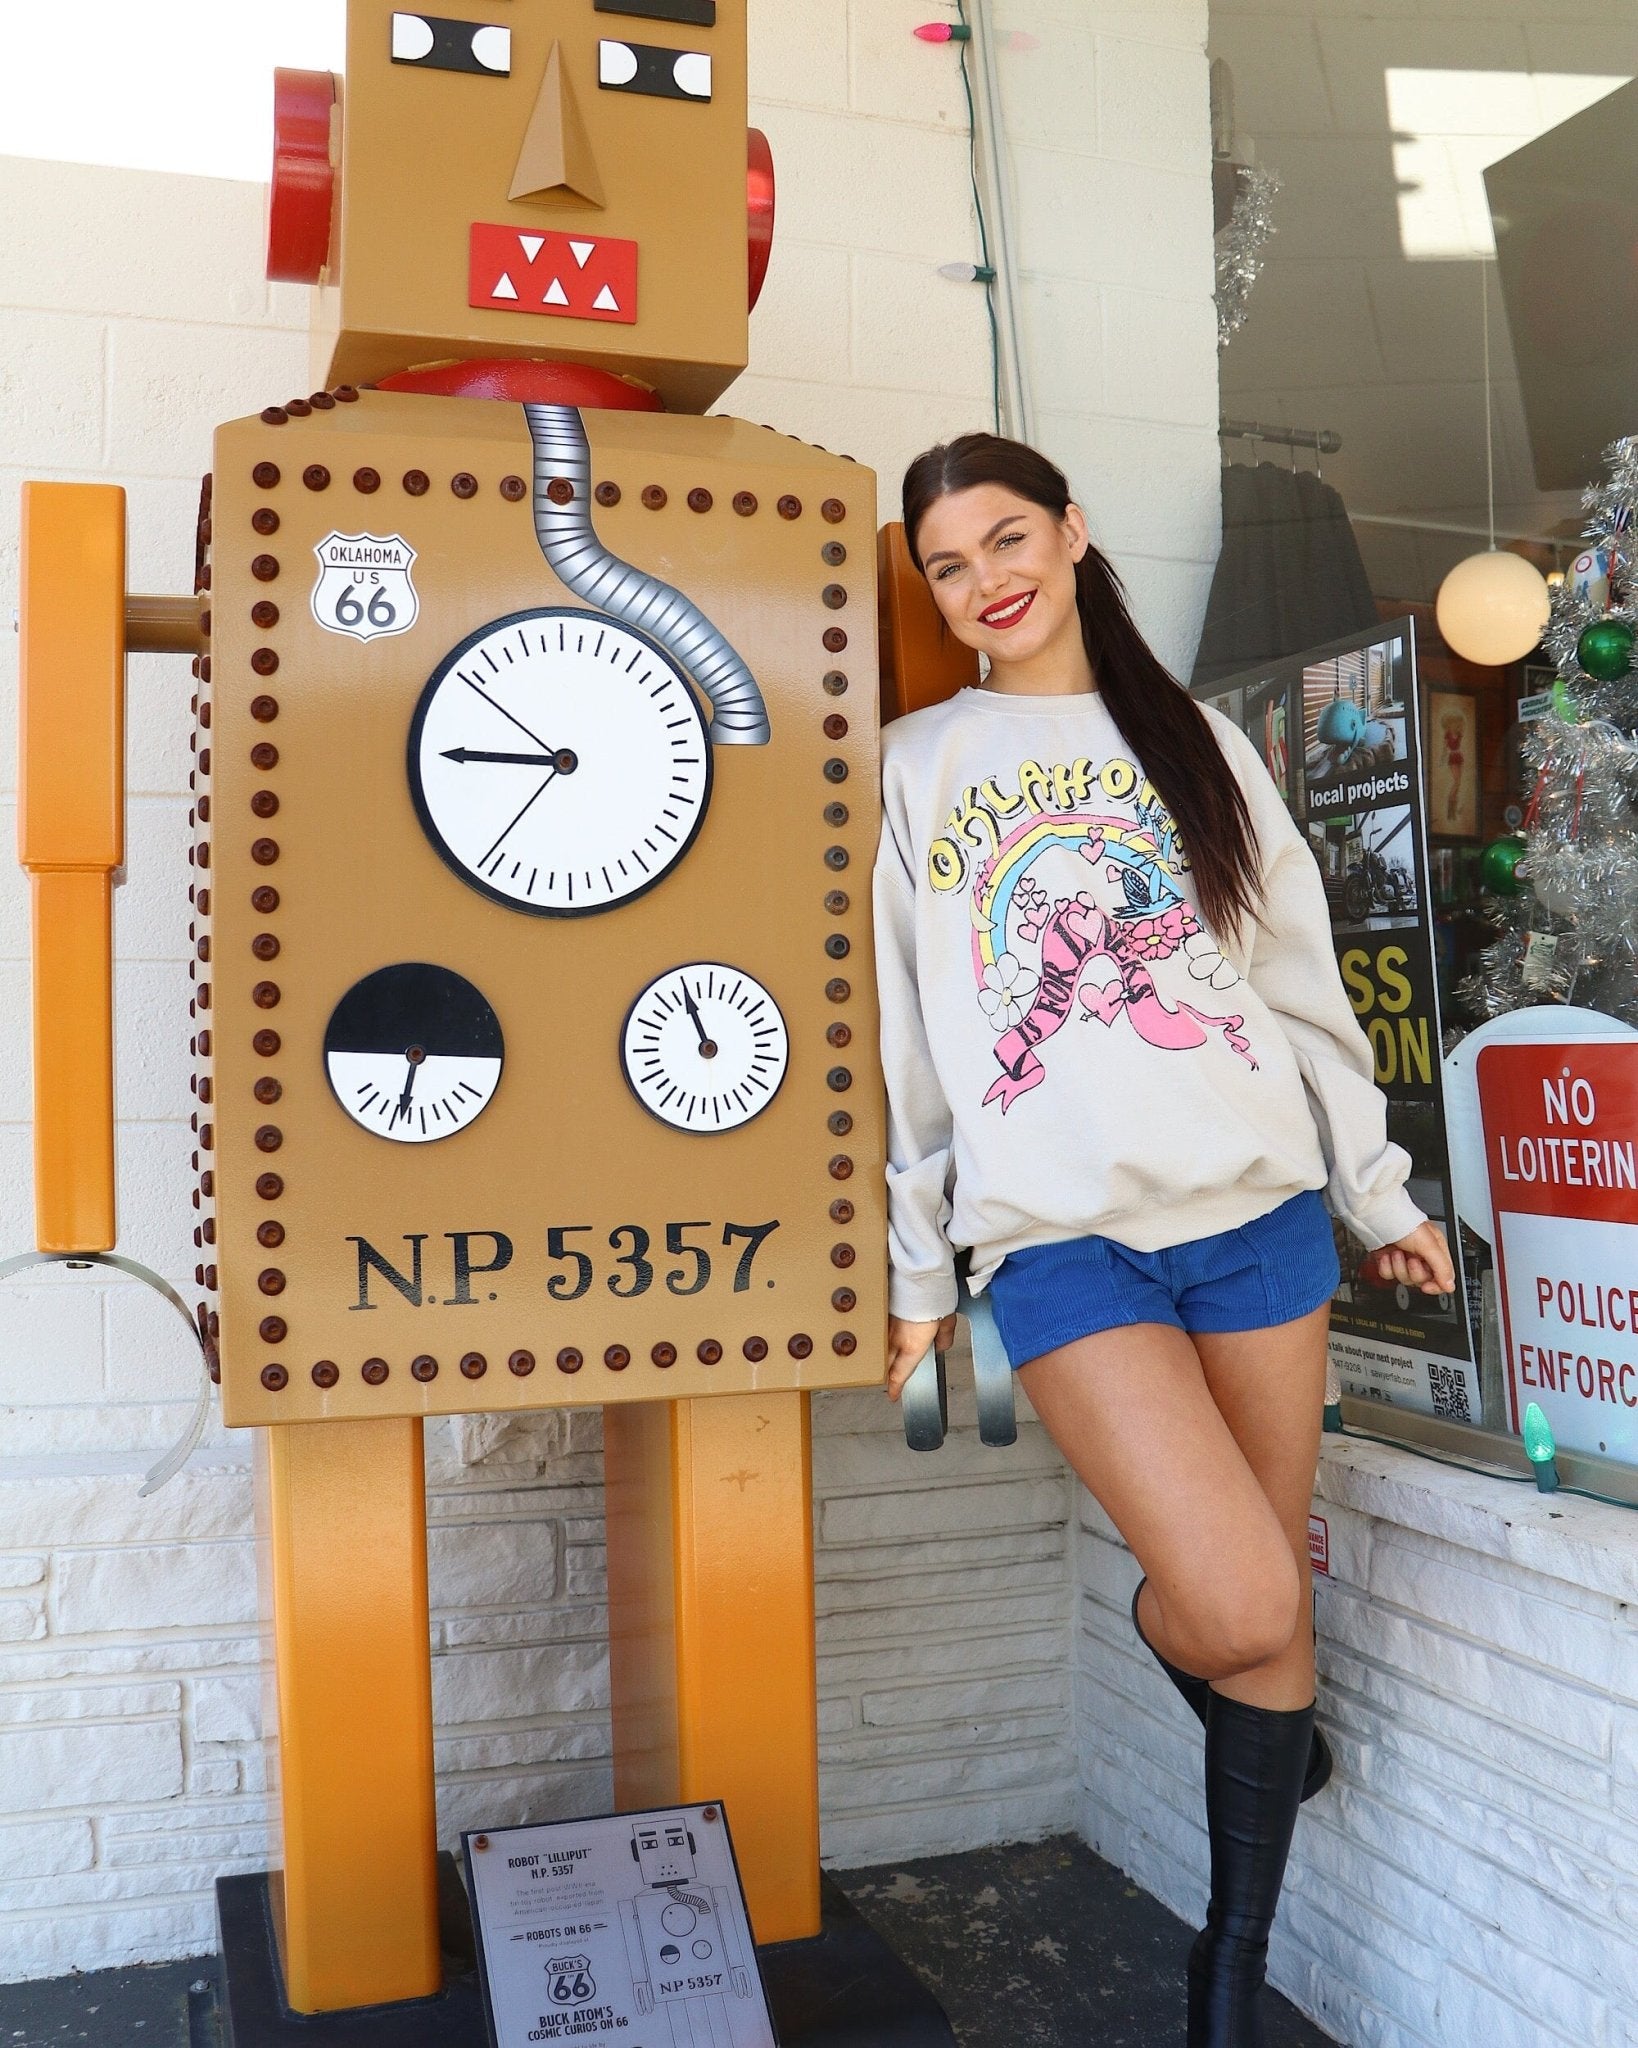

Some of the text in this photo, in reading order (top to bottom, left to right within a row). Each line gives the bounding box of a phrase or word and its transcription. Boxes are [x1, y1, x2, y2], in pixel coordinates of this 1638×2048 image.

[330, 546, 402, 564] OKLAHOMA
[353, 571, 380, 585] US
[335, 584, 396, 628] 66
[1310, 771, 1410, 808] local projects
[928, 757, 1191, 891] OKLAHO
[1014, 1016, 1043, 1048] IS
[1034, 960, 1080, 1020] FOR
[1542, 1078, 1596, 1126] NO
[345, 1229, 514, 1311] N.P.
[1536, 1276, 1638, 1334] POLICE
[1344, 1345, 1362, 1358] about
[1362, 1350, 1376, 1360] your
[1376, 1352, 1390, 1364] next
[508, 1847, 592, 1869] ROBOT "LILLIPUT"
[531, 1864, 574, 1879] N.P. 5357
[526, 1923, 592, 1942] ROBOTS ON 66
[552, 1958, 583, 1972] BUCK'S
[553, 1972, 590, 2001] 66
[528, 2016, 629, 2042] COSMIC CURIOS ON 66
[539, 2005, 614, 2029] BUCK ATOM'S
